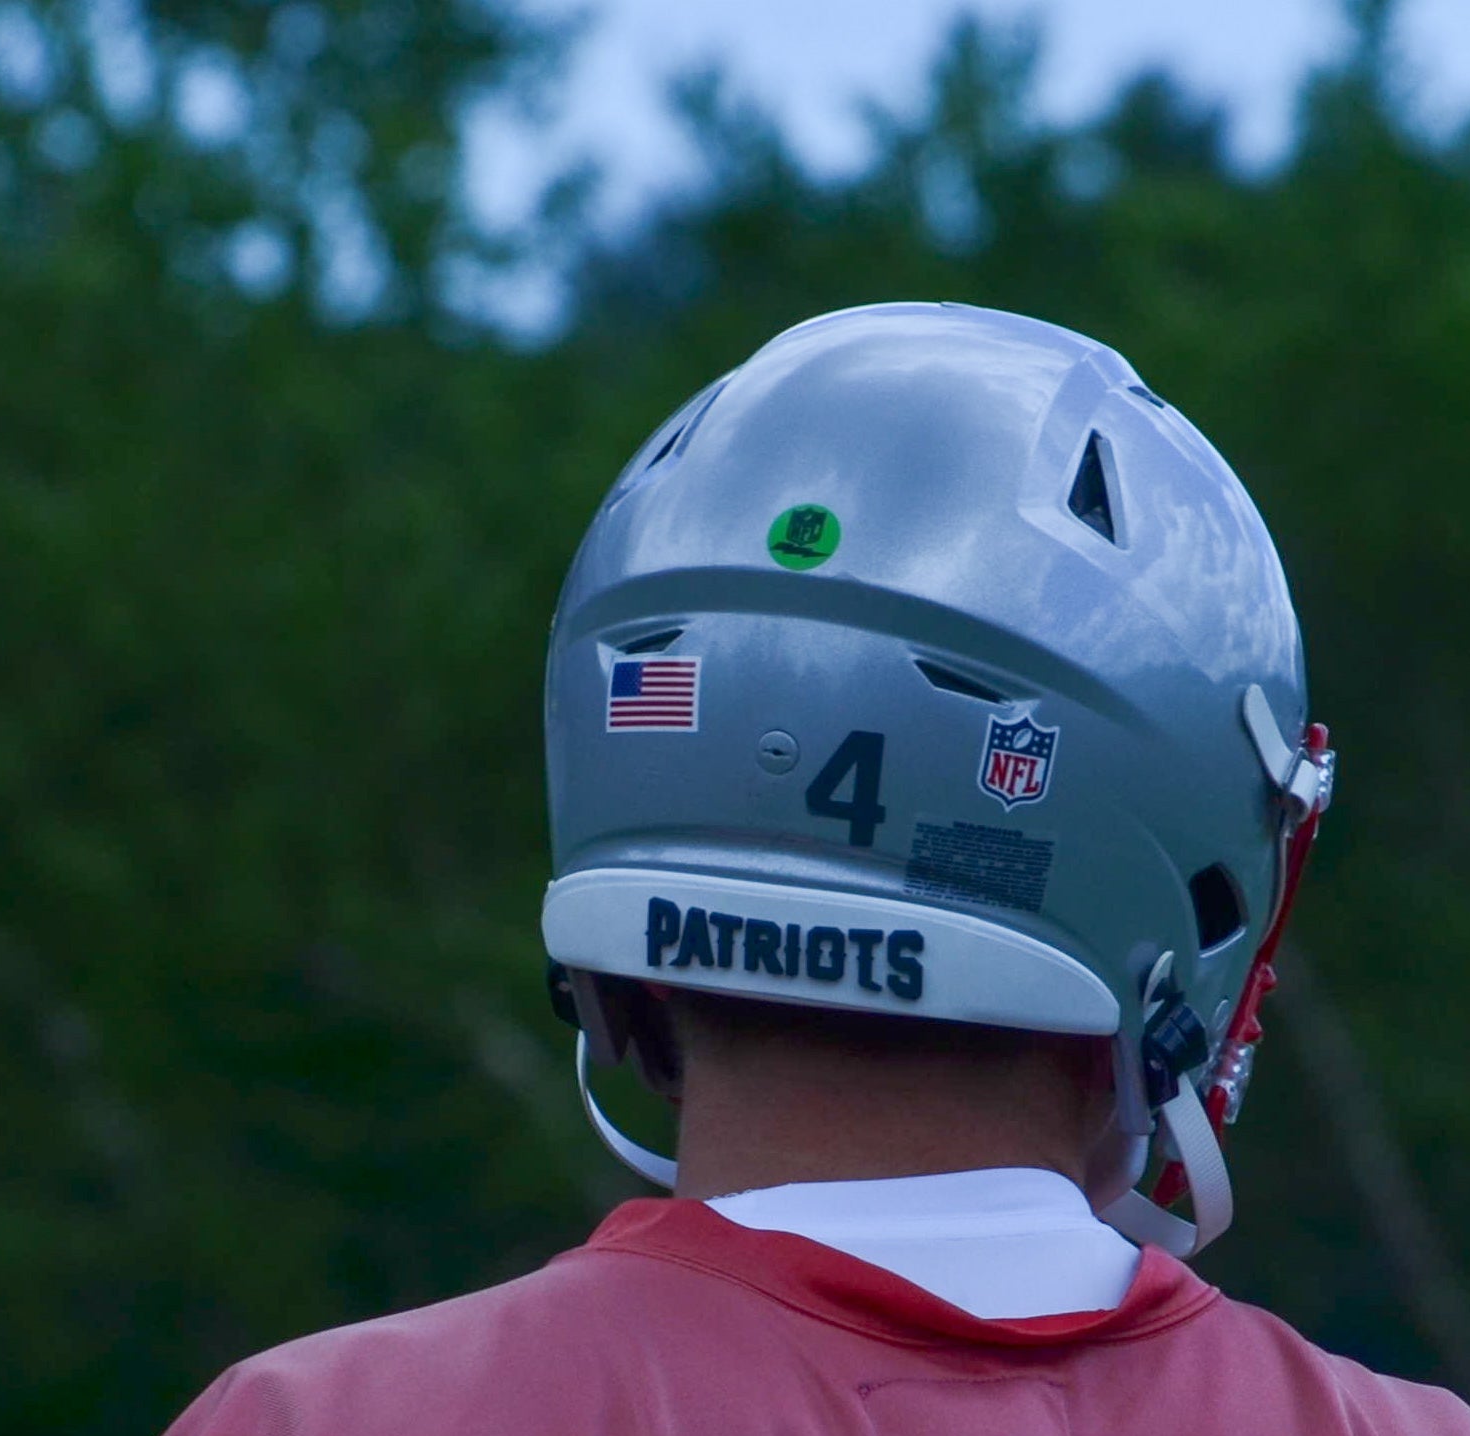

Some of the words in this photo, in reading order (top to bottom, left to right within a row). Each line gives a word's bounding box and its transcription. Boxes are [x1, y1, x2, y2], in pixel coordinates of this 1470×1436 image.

[805, 730, 886, 847] 4
[987, 752, 1041, 795] NFL
[646, 897, 924, 1000] PATRIOTS
